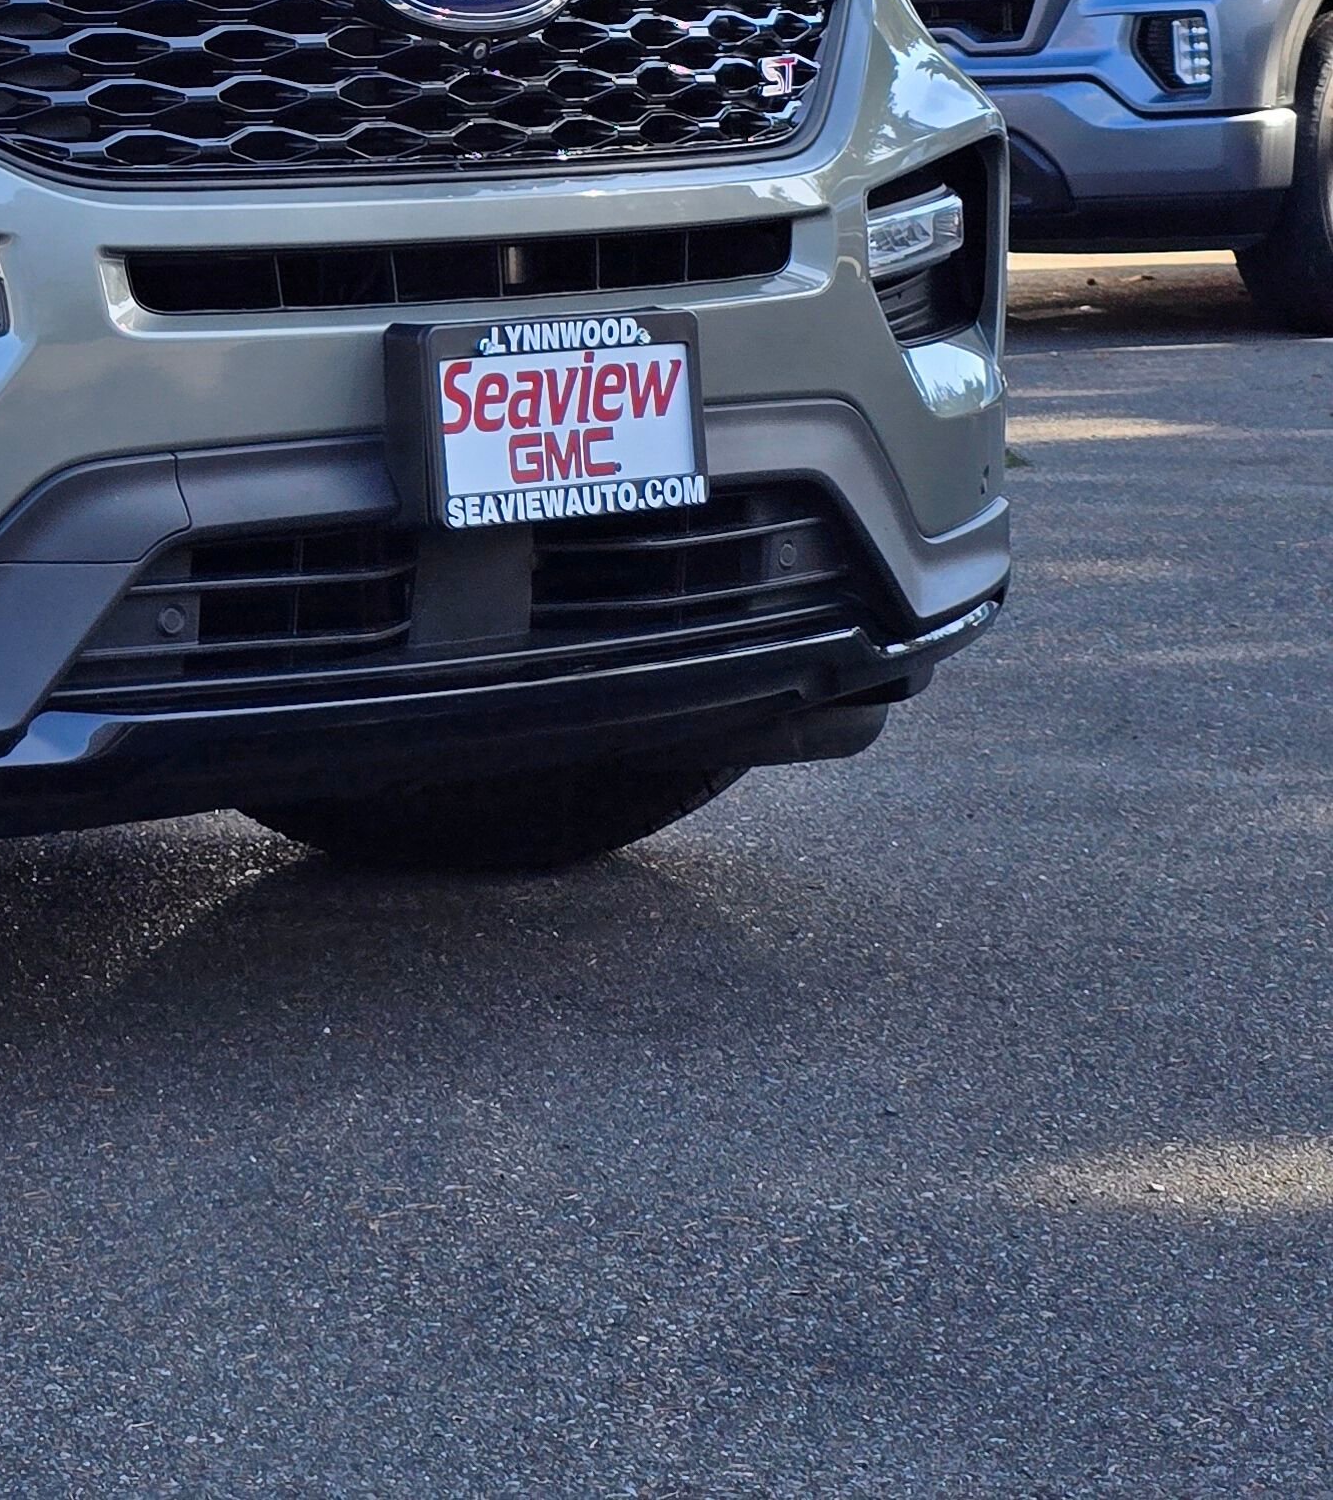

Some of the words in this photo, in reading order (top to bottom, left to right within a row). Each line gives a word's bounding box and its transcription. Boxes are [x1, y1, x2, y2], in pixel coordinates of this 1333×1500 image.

[761, 55, 798, 97] ST
[489, 317, 639, 353] LYNNWOOD
[441, 350, 683, 435] Seaview
[508, 426, 621, 485] GMC
[447, 475, 707, 529] SEAVIEWAUTO.COM
